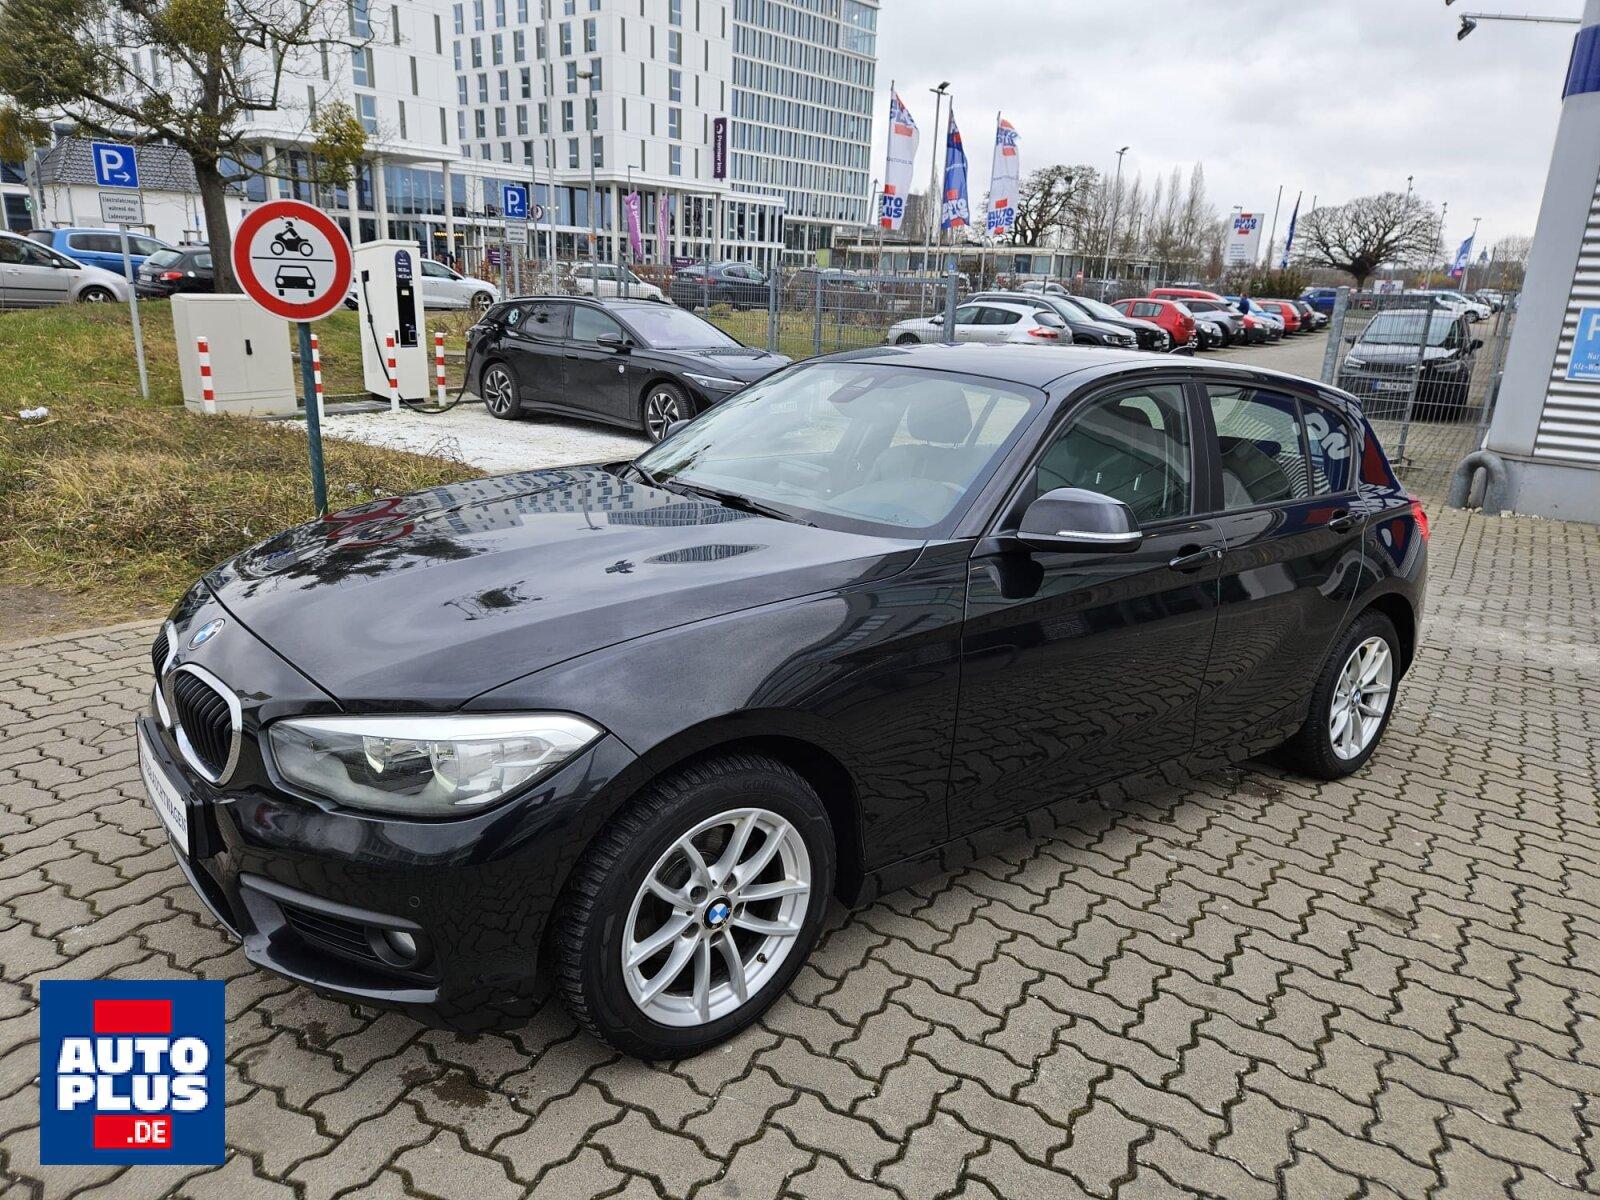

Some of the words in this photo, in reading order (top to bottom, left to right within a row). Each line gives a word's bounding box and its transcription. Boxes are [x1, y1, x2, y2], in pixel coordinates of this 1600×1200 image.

[99, 149, 123, 181] P
[507, 190, 519, 213] P
[882, 196, 903, 207] UTO
[882, 207, 903, 219] US
[988, 207, 1014, 220] AUTO
[988, 217, 1013, 230] PLUS
